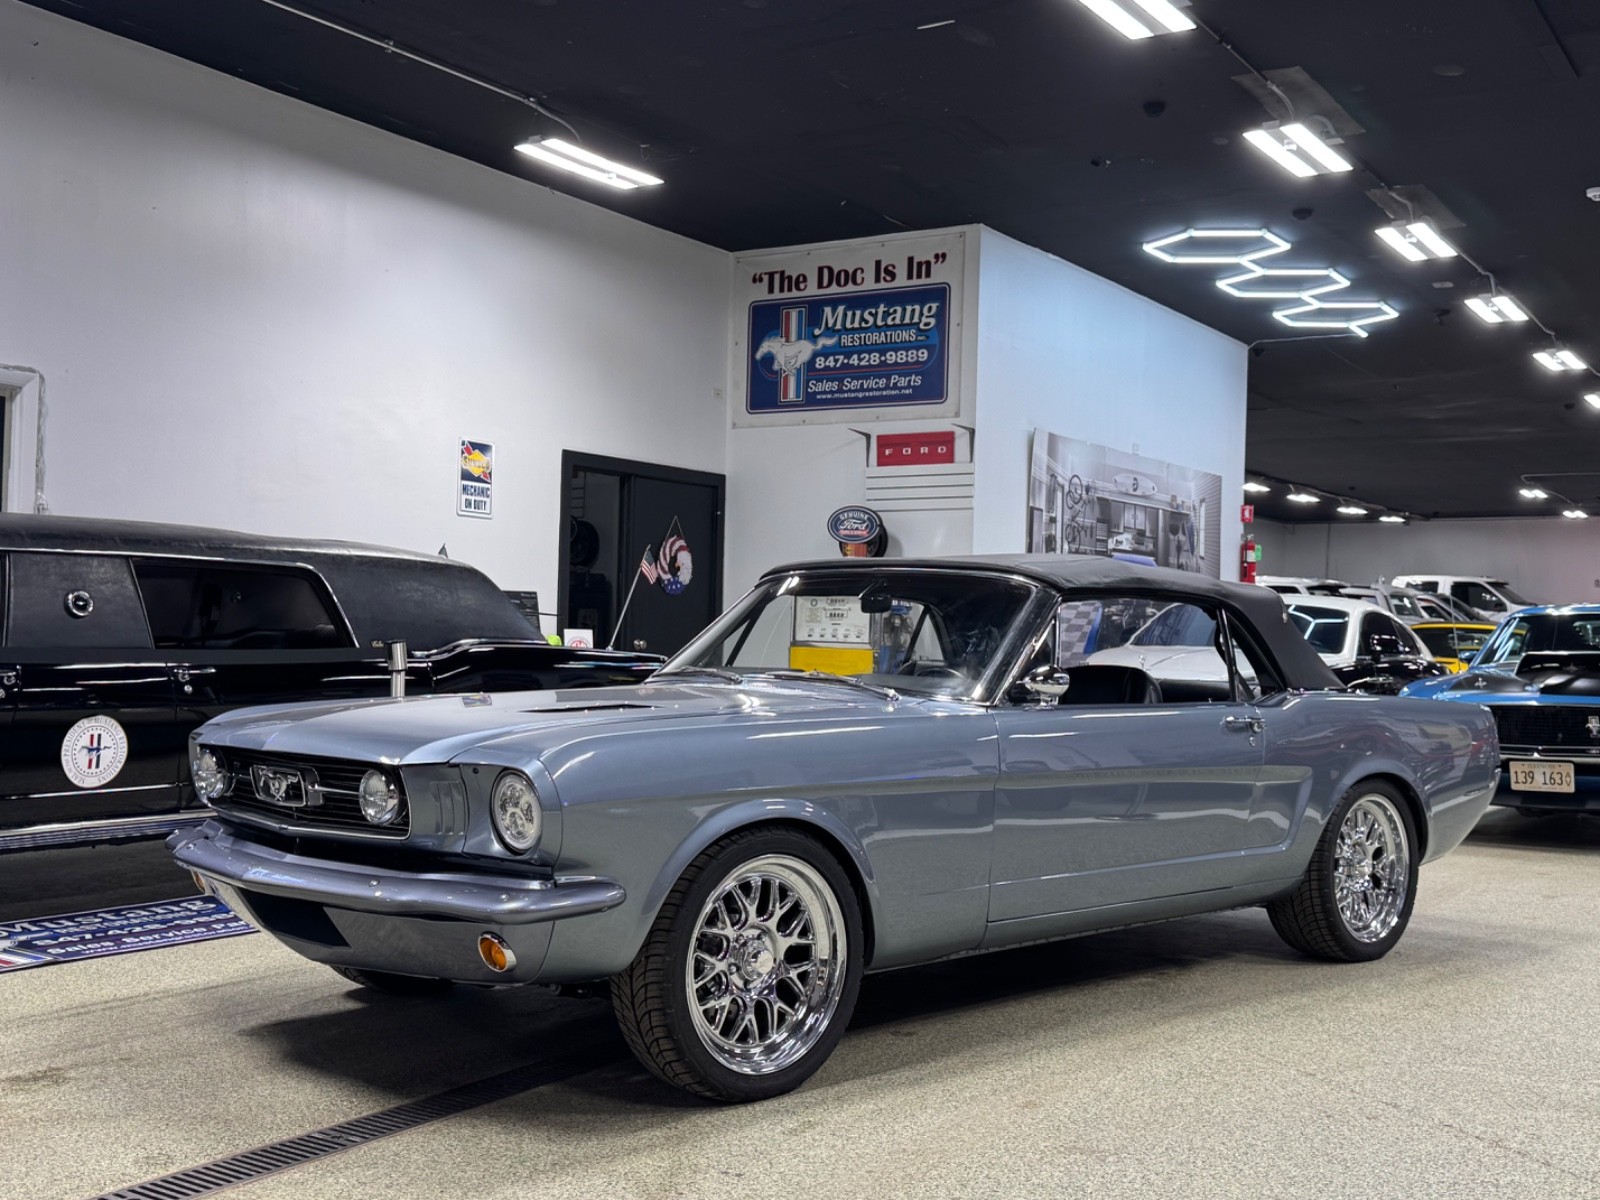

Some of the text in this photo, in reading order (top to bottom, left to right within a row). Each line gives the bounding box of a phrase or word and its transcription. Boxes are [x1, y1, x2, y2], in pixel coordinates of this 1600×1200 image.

[817, 265, 865, 290] Doc
[874, 259, 897, 284] Is
[813, 302, 939, 336] Mustang
[840, 329, 916, 347] RESTORATIONS
[808, 373, 922, 392] Sales Service Parts
[885, 446, 947, 456] FORD
[462, 484, 491, 498] MECHANIC
[464, 498, 487, 511] ON DUTY
[839, 518, 869, 530] Ford
[1513, 770, 1535, 785] 139
[1541, 771, 1564, 786] 163
[47, 941, 115, 954] Sales
